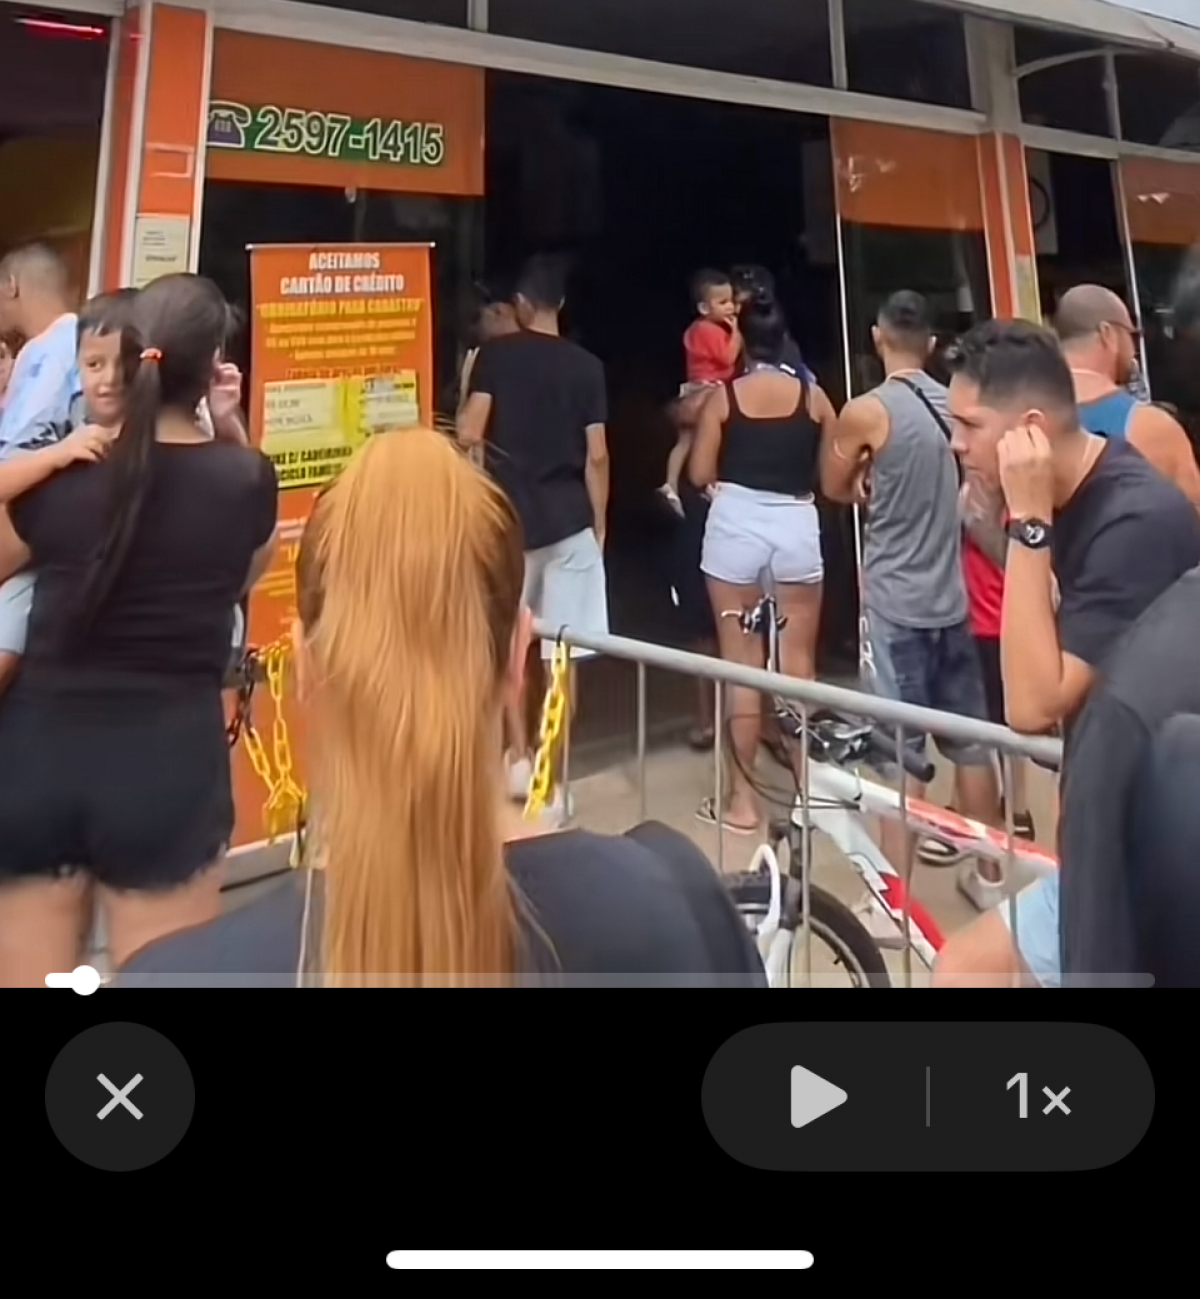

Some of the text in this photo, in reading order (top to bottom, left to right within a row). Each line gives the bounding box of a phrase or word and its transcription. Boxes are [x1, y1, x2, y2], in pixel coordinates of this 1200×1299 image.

[254, 105, 445, 165] 2597-1415
[309, 252, 380, 270] ACEITAMOS
[280, 272, 404, 295] CARTÃO DE CRÉDITO
